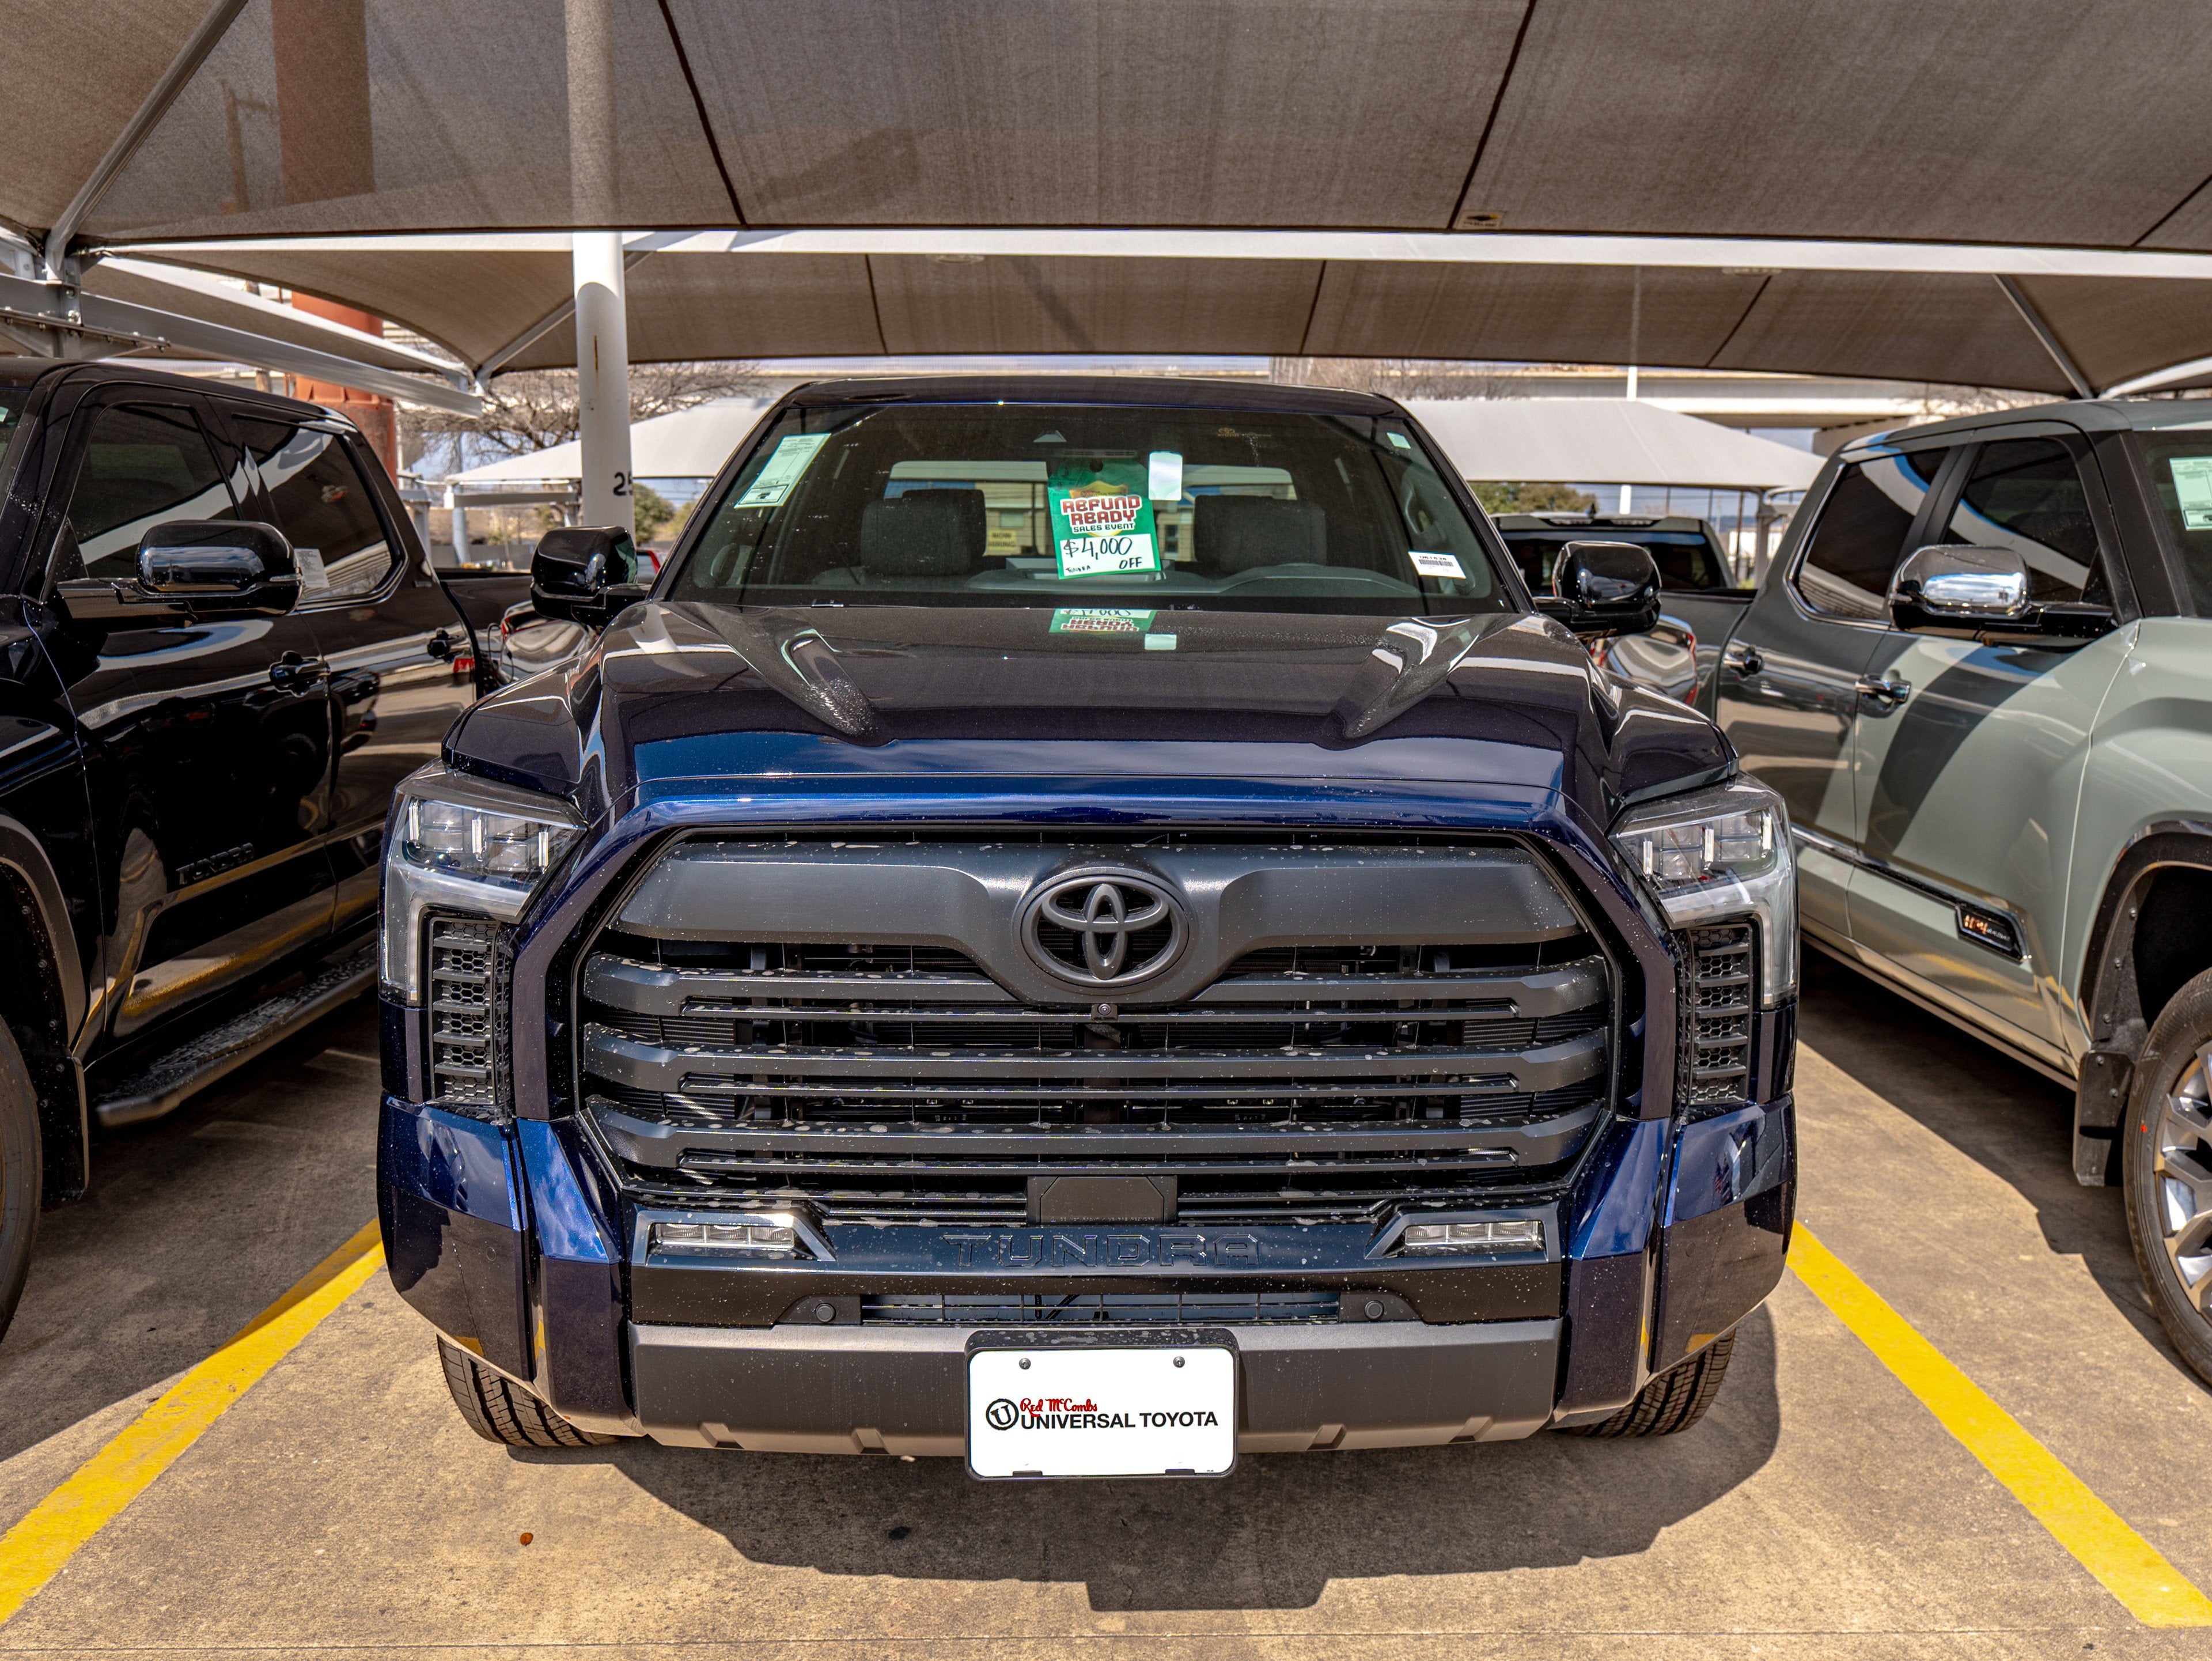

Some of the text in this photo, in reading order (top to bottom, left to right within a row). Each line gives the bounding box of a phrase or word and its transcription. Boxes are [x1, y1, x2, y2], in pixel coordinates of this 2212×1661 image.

[1062, 496, 1141, 513] REFUND
[1071, 510, 1135, 525] READY
[1073, 523, 1135, 533] SALES EVENT
[1063, 537, 1132, 560] $4,000
[1119, 557, 1143, 570] OFF
[176, 842, 254, 885] TUNDRA
[942, 1234, 1259, 1267] TUNDRA
[1020, 1398, 1098, 1417] Red McCombs
[1021, 1411, 1218, 1429] UNIVERSAL TOYOTA
